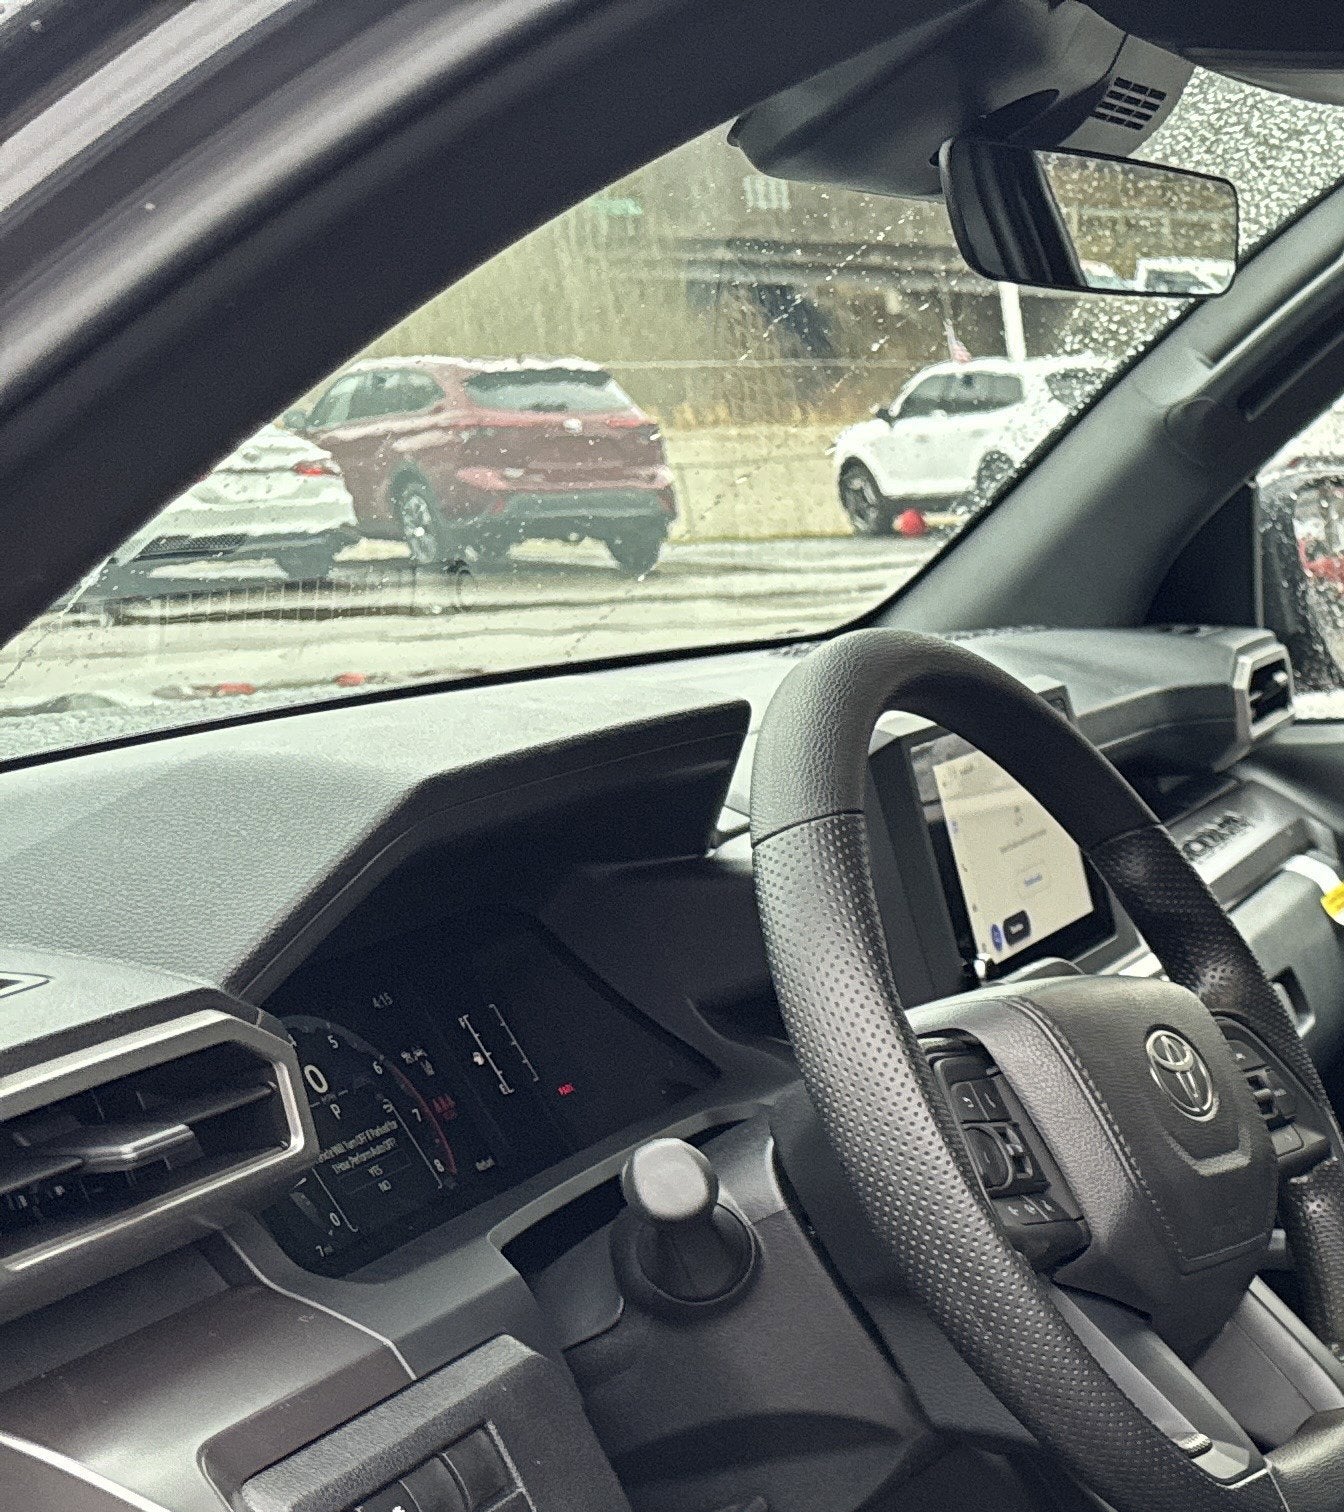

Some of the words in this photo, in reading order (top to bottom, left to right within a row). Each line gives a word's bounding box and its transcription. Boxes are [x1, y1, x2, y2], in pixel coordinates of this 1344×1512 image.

[327, 1034, 339, 1049] 5
[372, 1060, 383, 1075] 6
[303, 1064, 329, 1094] 0
[329, 1103, 341, 1120] P
[411, 1108, 422, 1123] 7
[433, 1158, 445, 1173] 8
[329, 1212, 341, 1227] 0
